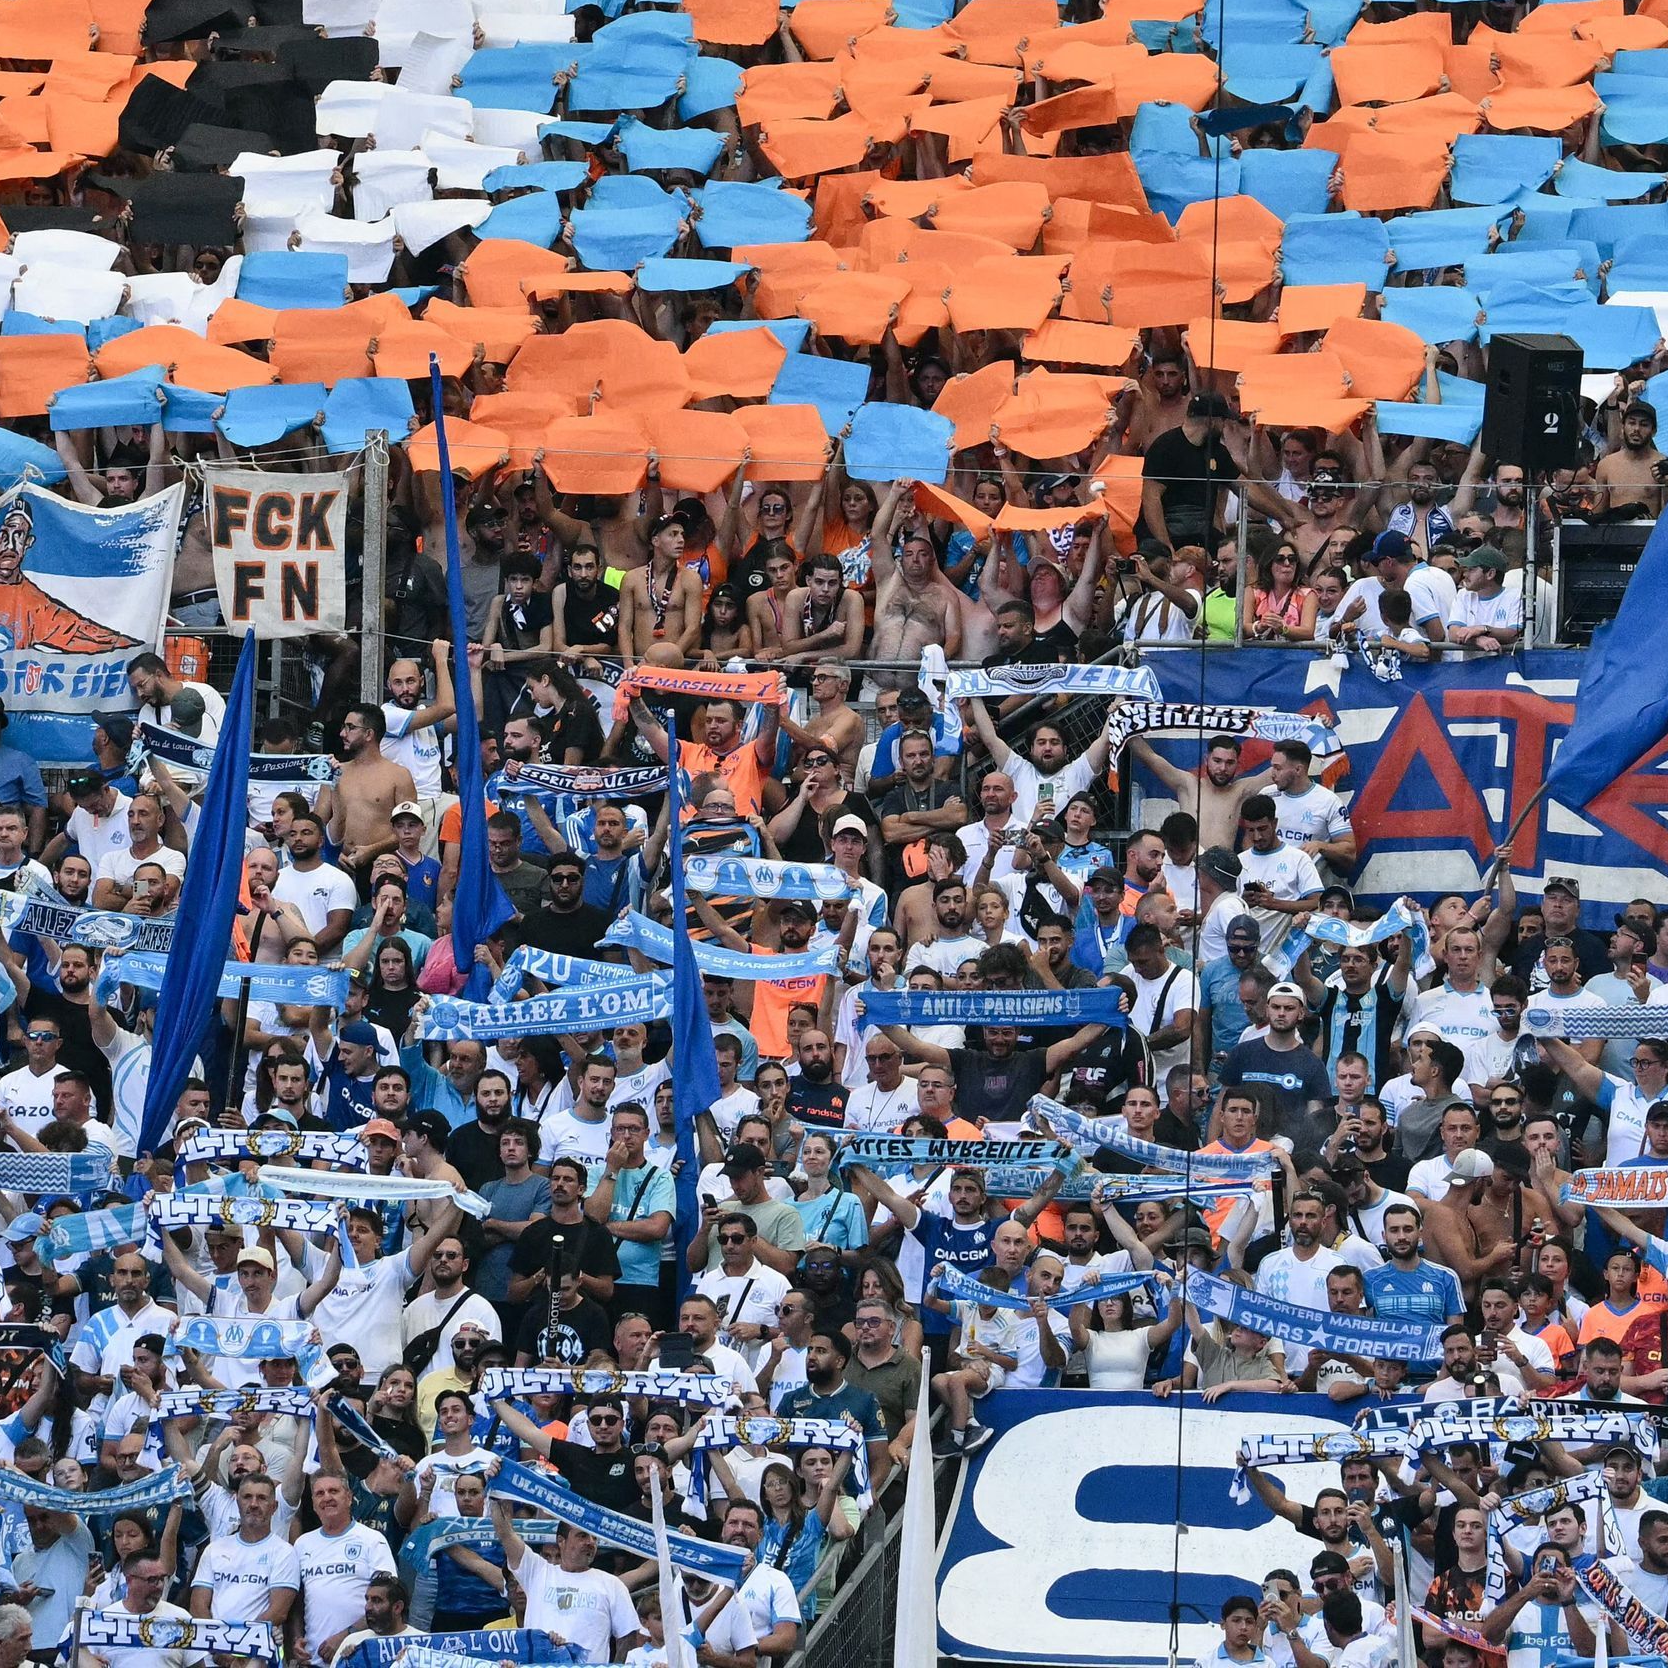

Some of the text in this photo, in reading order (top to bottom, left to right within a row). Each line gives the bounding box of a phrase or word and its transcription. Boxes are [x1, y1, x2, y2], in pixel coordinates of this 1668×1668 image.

[212, 484, 340, 551] FCK
[25, 904, 75, 938] ALLEZ
[729, 956, 805, 970] MARSEILLE
[471, 989, 651, 1029] ALLEZ L'OM
[921, 995, 1064, 1016] ANTI PARISIENS
[1588, 1173, 1668, 1200] JAMAIS
[1239, 1289, 1423, 1336] SUPPORTERS MARSEILLAIS
[1239, 1309, 1421, 1362] STARS FOREVER
[469, 1631, 519, 1655] L'OM
